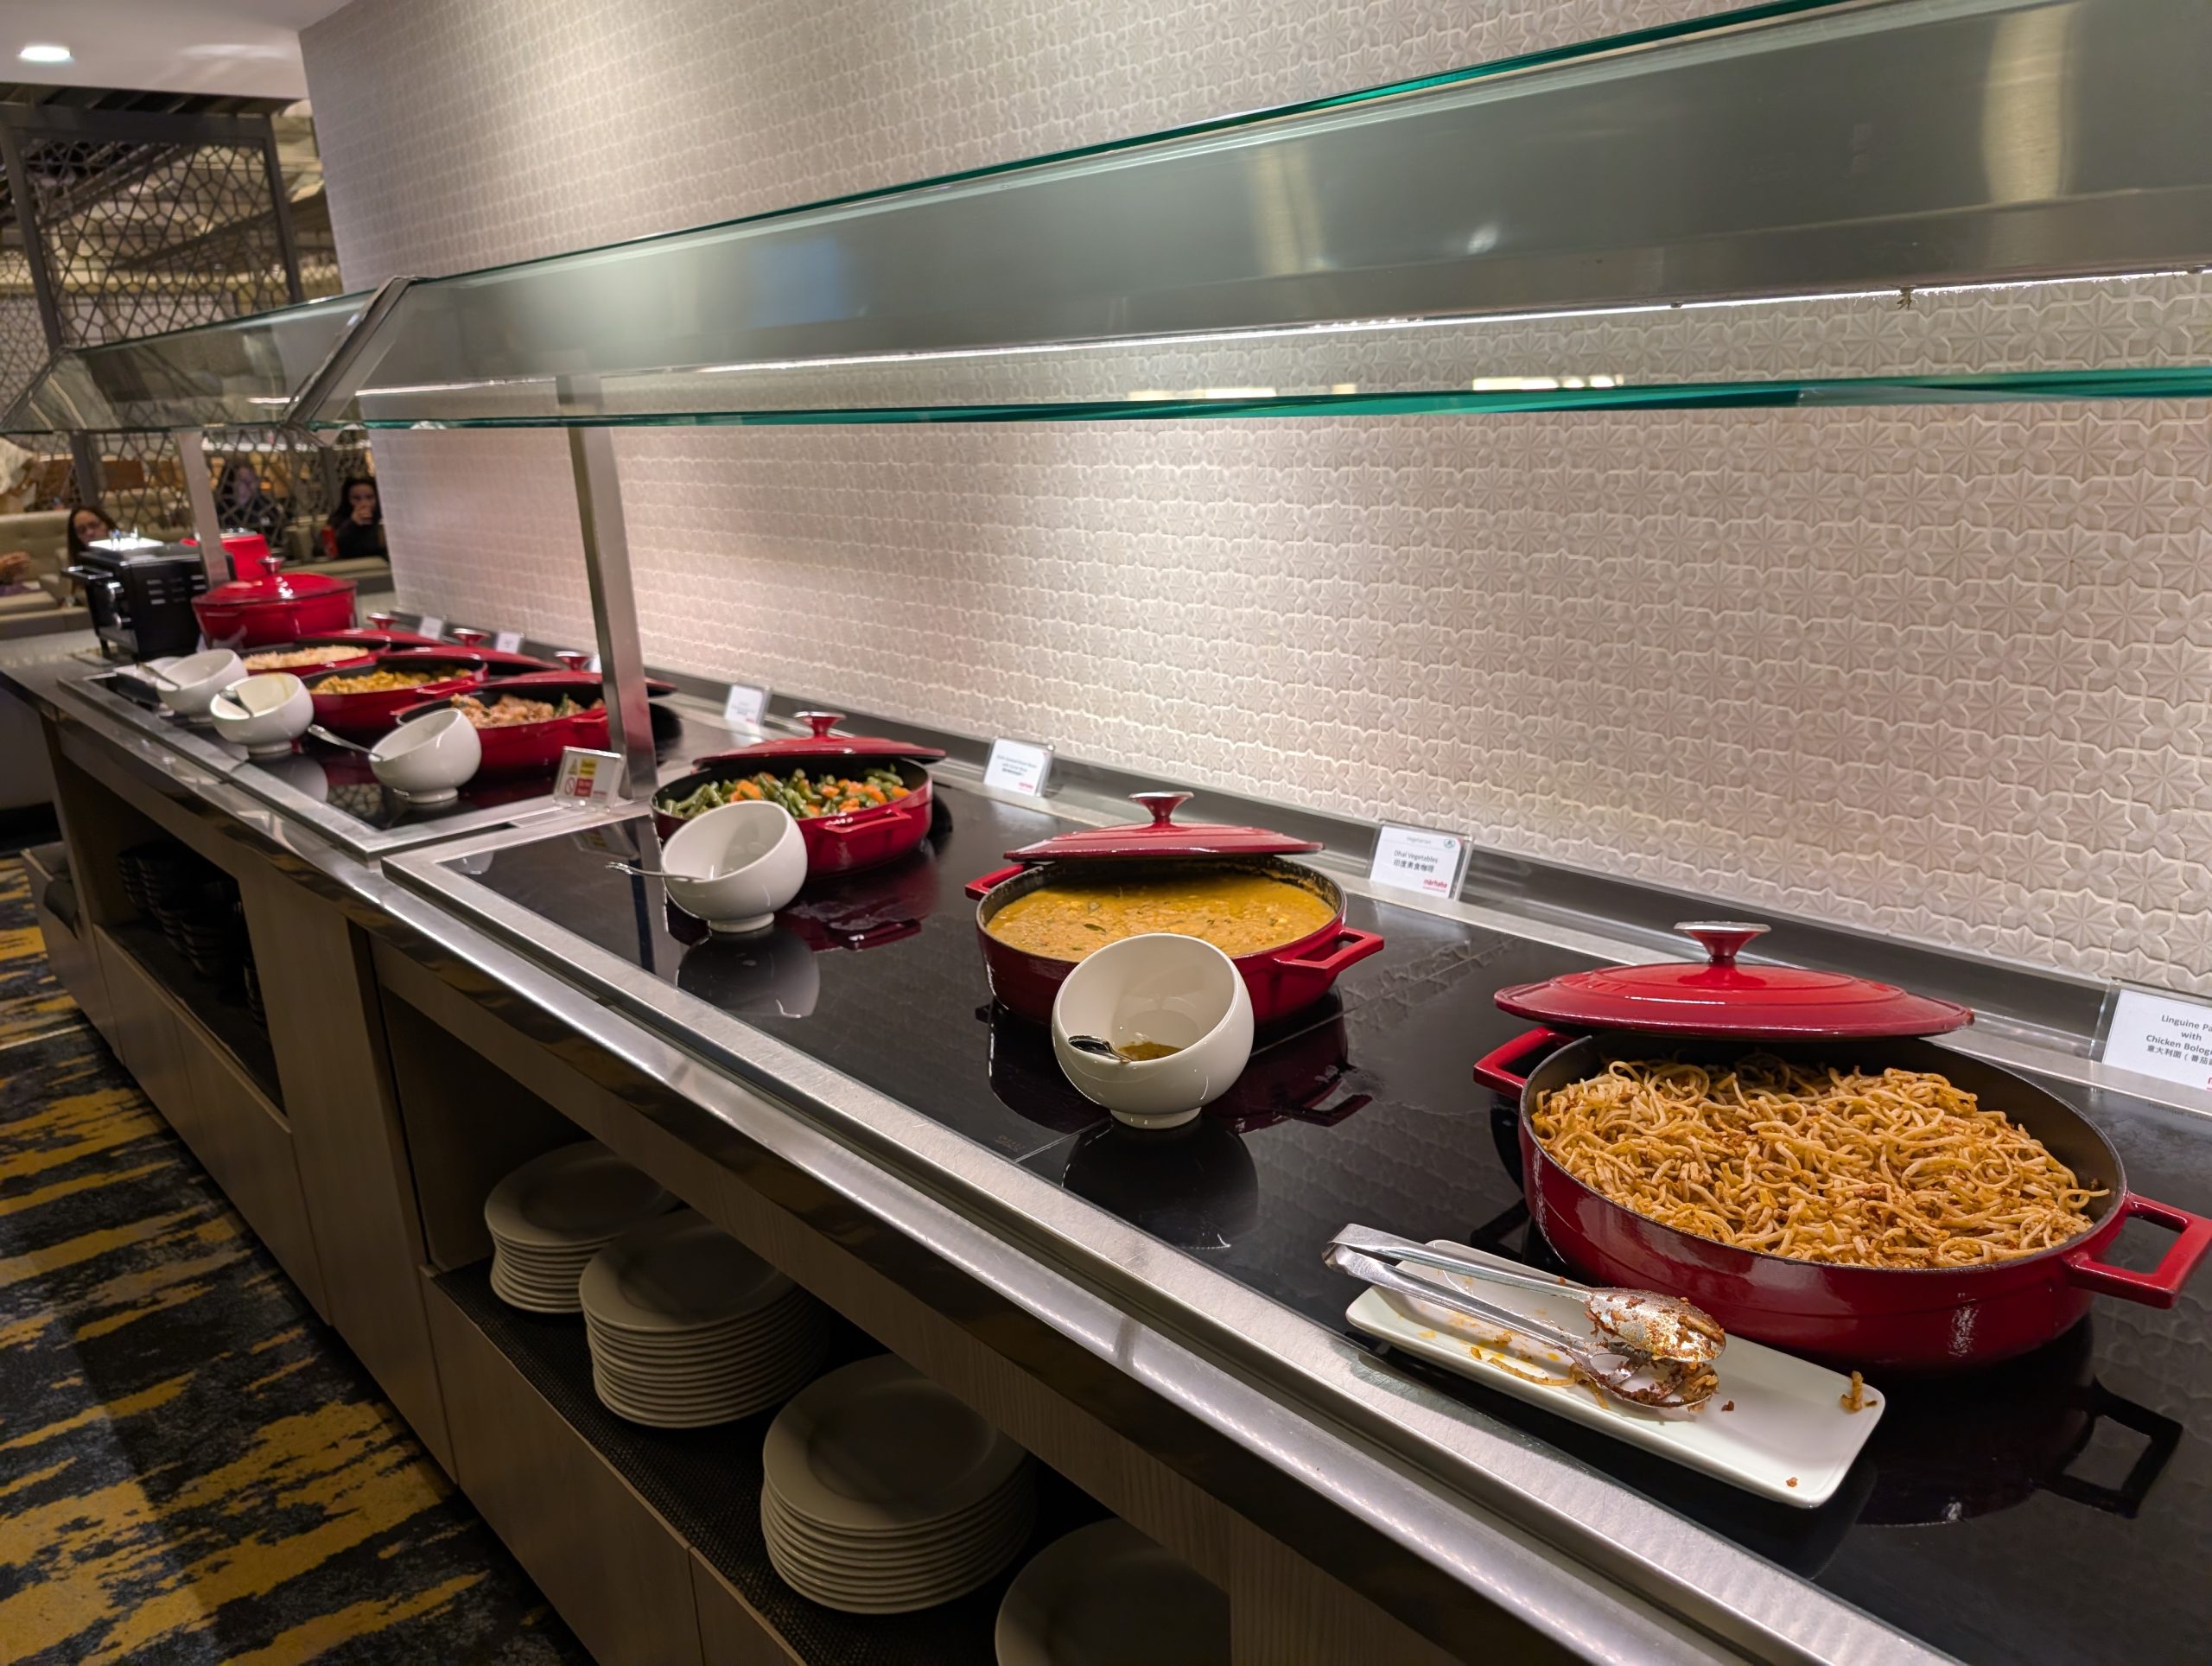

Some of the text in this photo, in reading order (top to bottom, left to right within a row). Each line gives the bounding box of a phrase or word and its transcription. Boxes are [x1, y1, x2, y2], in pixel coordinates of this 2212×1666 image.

[1408, 852, 1438, 863] Vegetables
[2161, 1014, 2200, 1029] Linguine
[2145, 1034, 2181, 1048] Chicken
[2181, 1032, 2202, 1041] with
